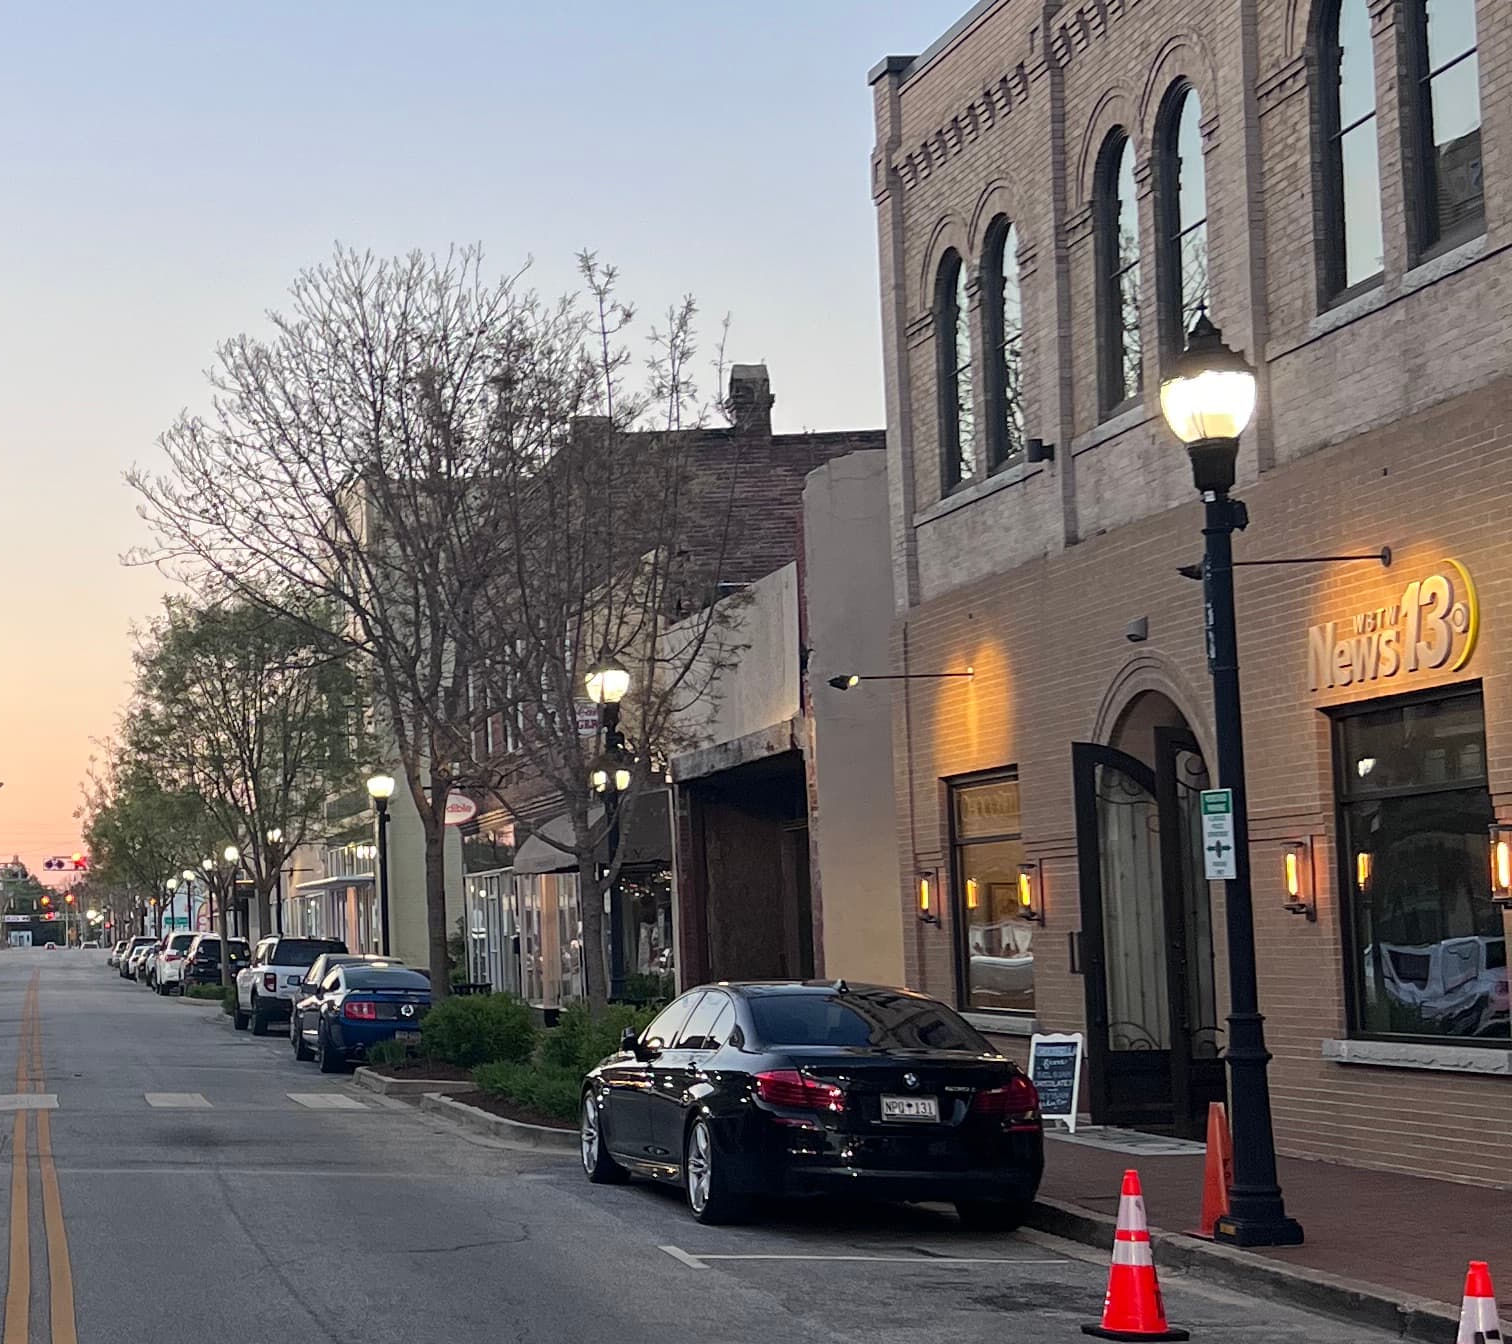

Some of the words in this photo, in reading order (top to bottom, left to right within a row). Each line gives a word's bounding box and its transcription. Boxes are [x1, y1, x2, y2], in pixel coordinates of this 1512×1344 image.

[1352, 605, 1400, 633] WBTW
[1308, 622, 1400, 692] News
[1400, 575, 1454, 673] 13
[915, 1102, 934, 1115] 131
